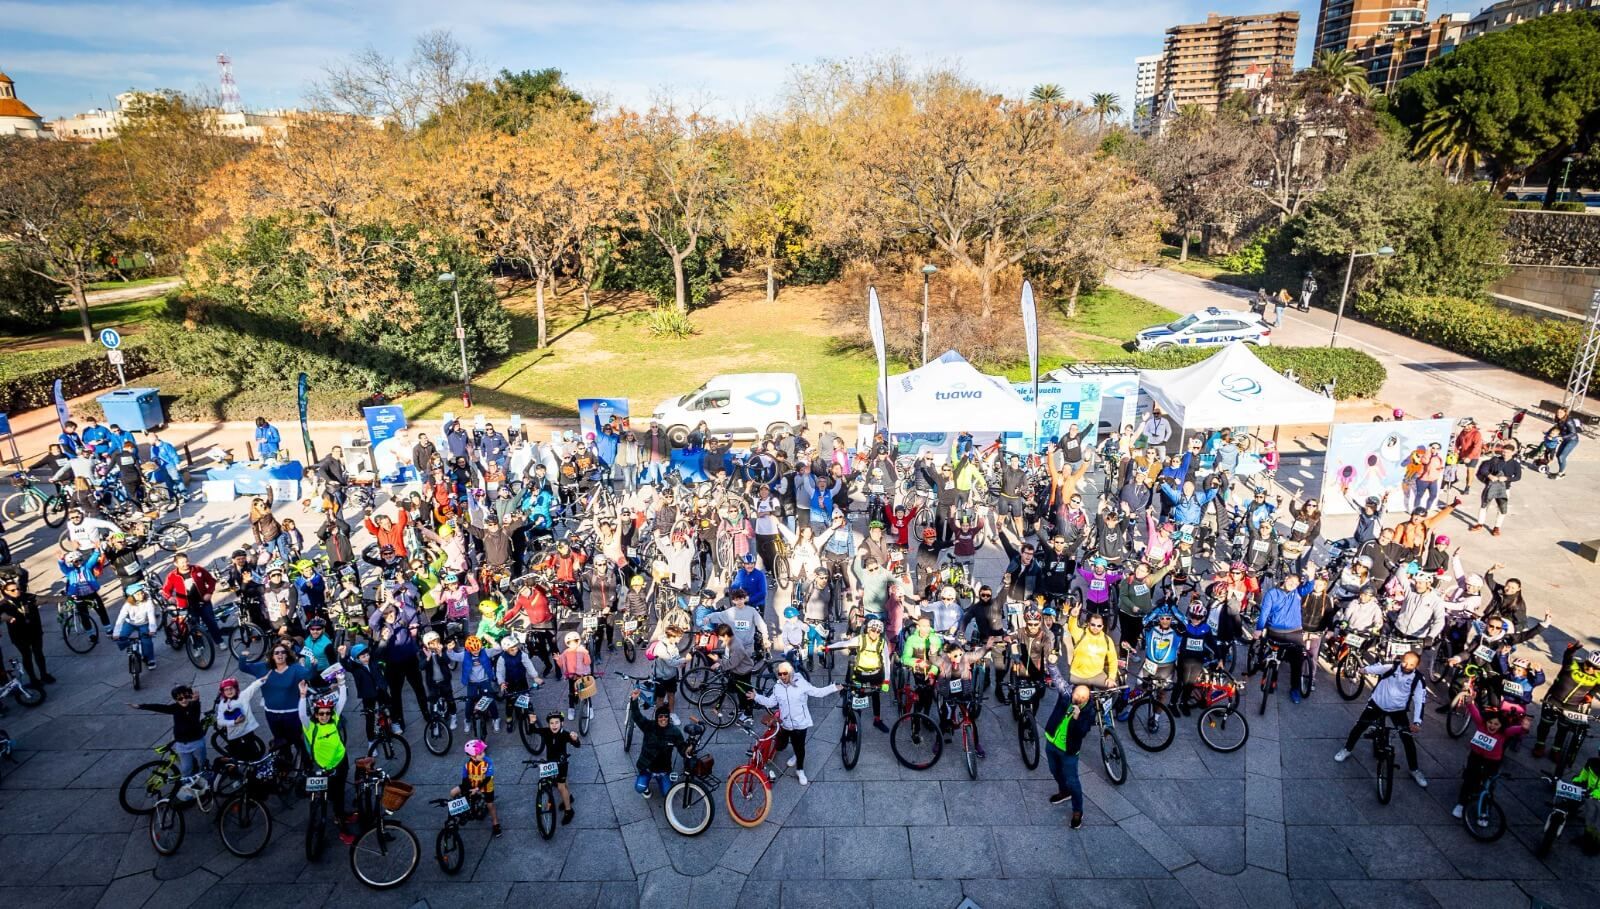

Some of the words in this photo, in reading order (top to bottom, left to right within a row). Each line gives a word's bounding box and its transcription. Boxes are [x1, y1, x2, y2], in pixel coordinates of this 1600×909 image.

[935, 390, 982, 400] tuawa
[1478, 734, 1493, 744] 001
[543, 763, 555, 771] 001
[1561, 784, 1577, 793] 001
[452, 799, 464, 808] 001
